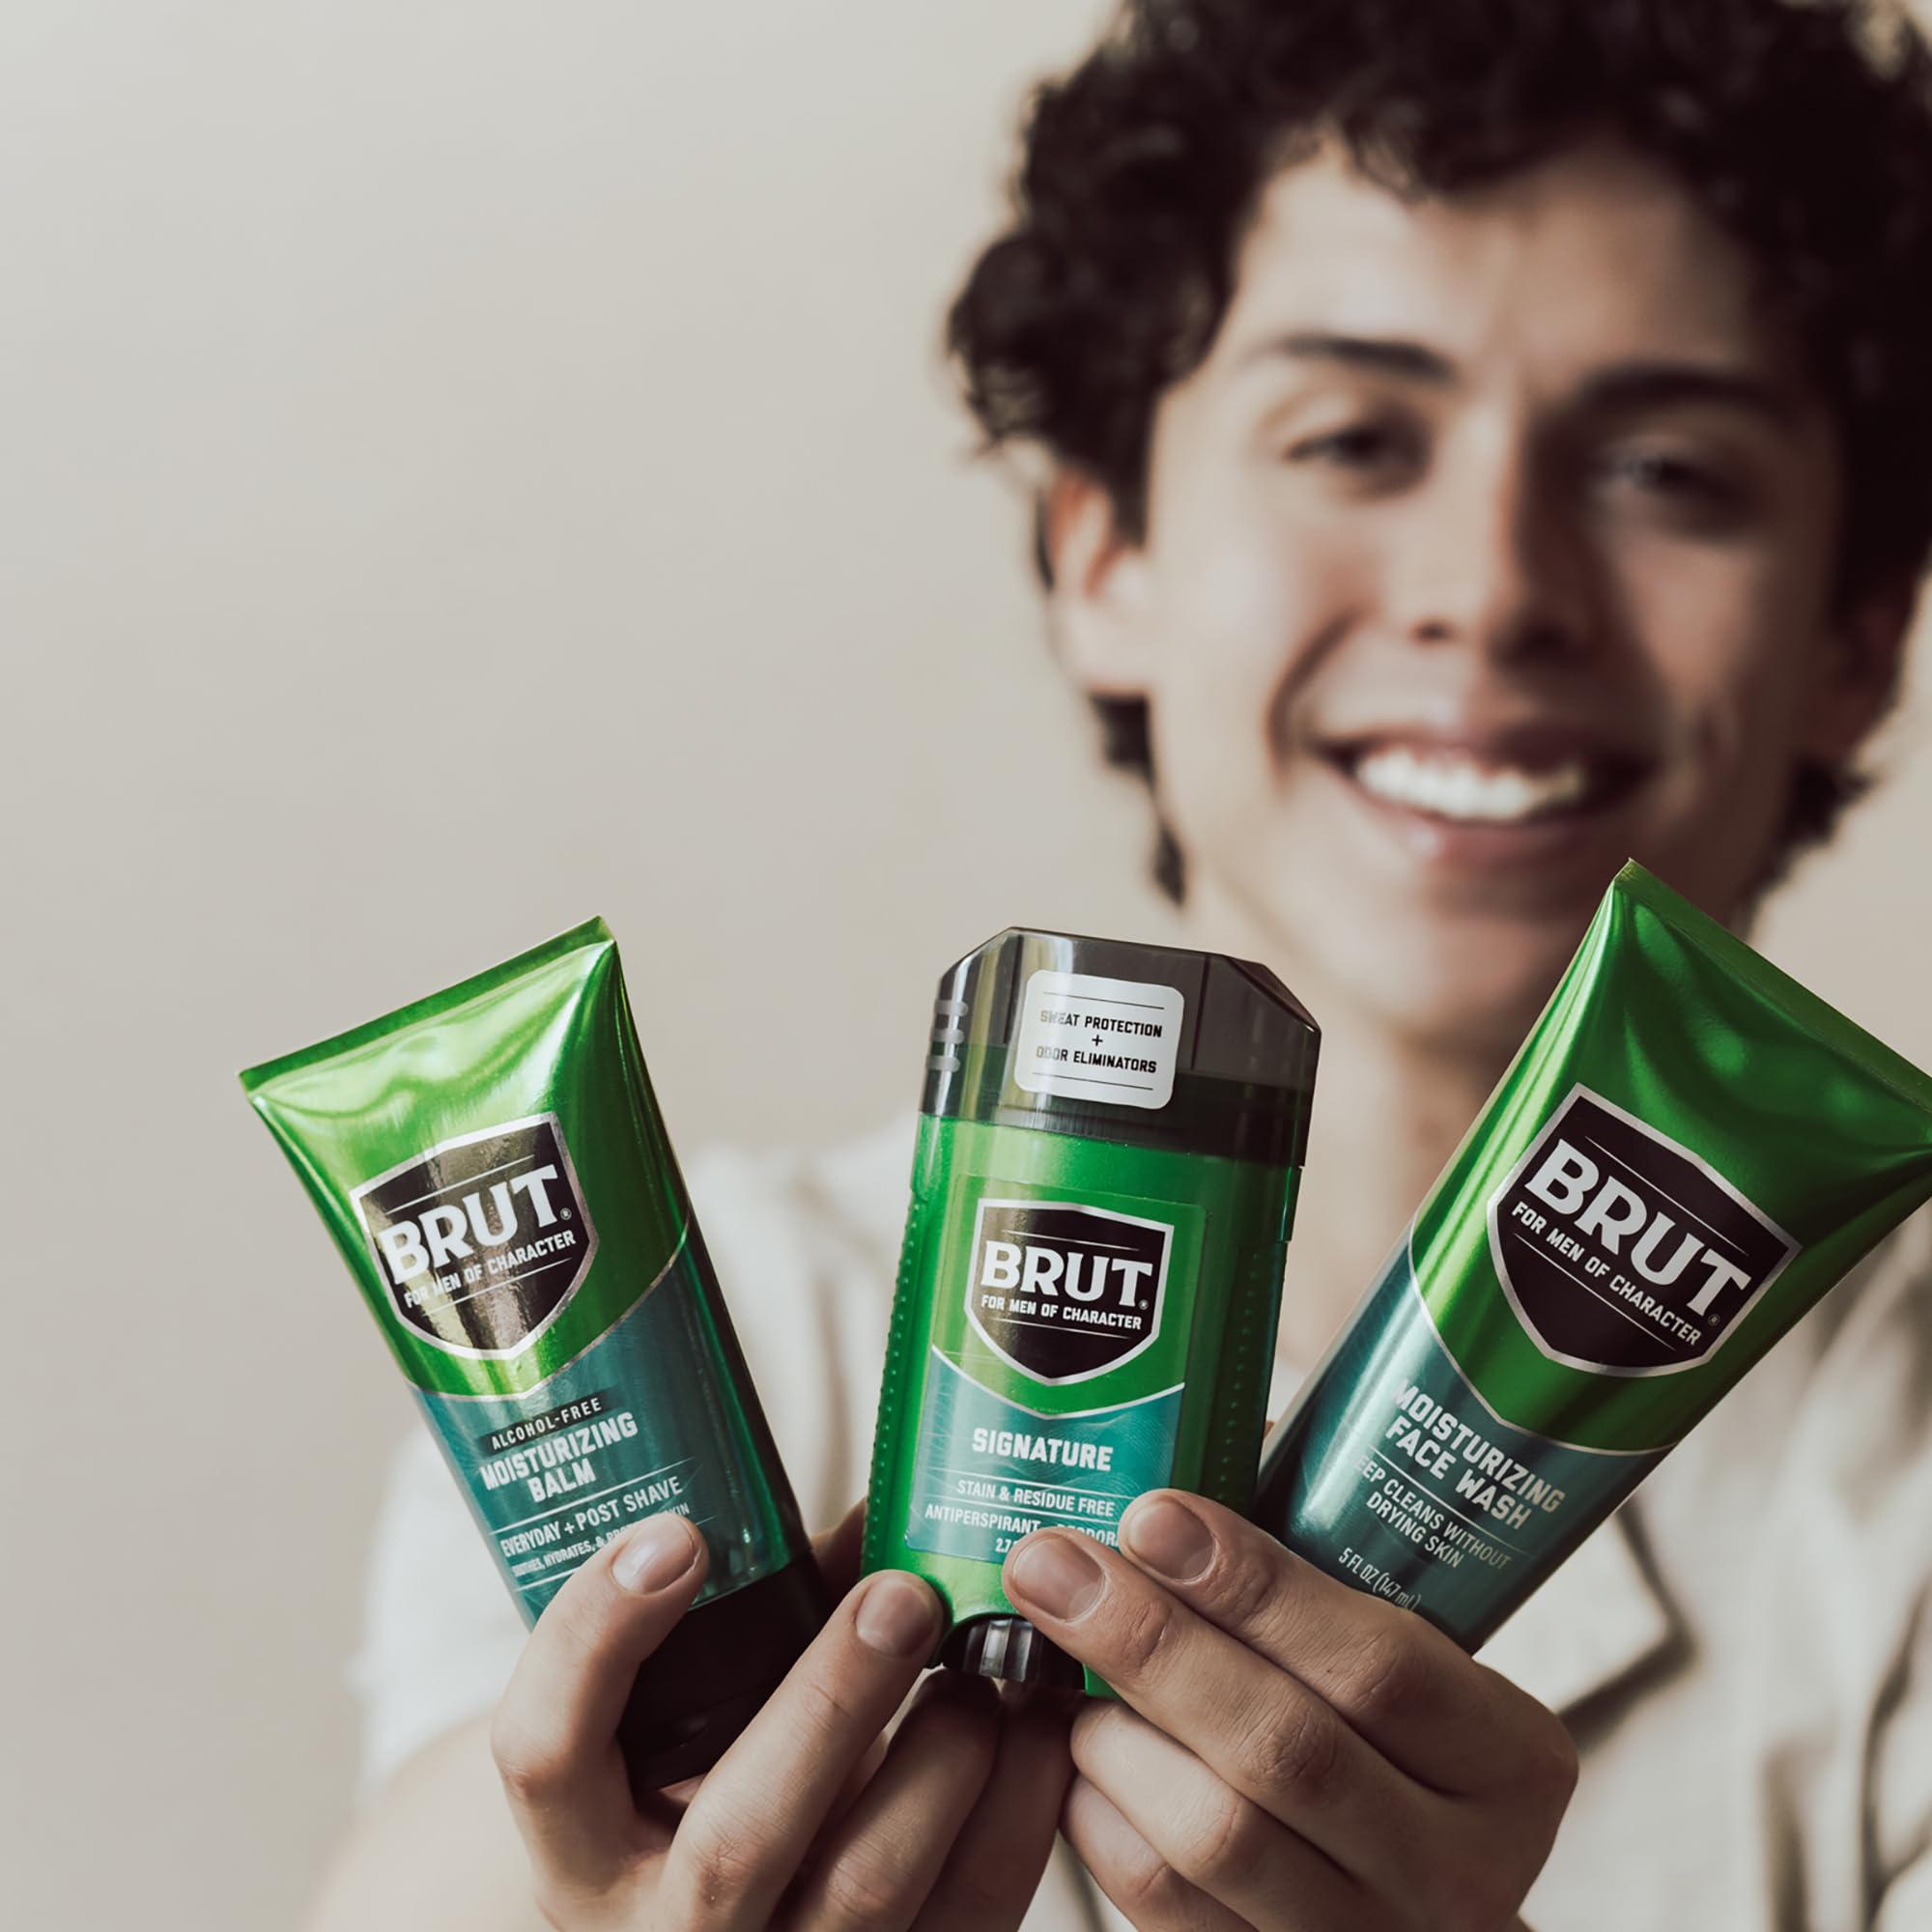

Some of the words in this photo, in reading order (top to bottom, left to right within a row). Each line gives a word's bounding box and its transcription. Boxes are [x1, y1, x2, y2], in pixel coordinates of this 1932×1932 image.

[1040, 1010, 1080, 1026] SWEAT
[1084, 1015, 1162, 1037] PROTECTION
[1092, 1035, 1103, 1046] +
[1036, 1045, 1068, 1062] ODOR
[1073, 1050, 1157, 1073] ELIMINATORS
[378, 1163, 558, 1285] BRUT
[1523, 1137, 1752, 1317] BRUT
[404, 1286, 429, 1308] FOR
[433, 1272, 462, 1296] MEN
[465, 1263, 484, 1285] OF
[487, 1229, 577, 1275] CHARACTER
[980, 1239, 1153, 1307] BRUT
[1511, 1201, 1547, 1236] FOR
[1546, 1228, 1586, 1263] MEN
[1584, 1256, 1611, 1278] OF
[1608, 1274, 1703, 1346] CHARACTER
[980, 1294, 1006, 1309] FOR
[1009, 1297, 1037, 1315] MEN
[1040, 1301, 1059, 1318] OF
[1063, 1306, 1143, 1330] CHARACTER
[480, 1411, 639, 1491] MOISTURIZING
[491, 1397, 602, 1450] ALCOHOL-FREE
[972, 1428, 1114, 1471] SIGNATURE
[1392, 1378, 1566, 1514] MOISTURIZING
[526, 1458, 596, 1503] BALM
[957, 1479, 998, 1499] STAIN
[1000, 1488, 1010, 1501] &
[1013, 1489, 1075, 1512] RESIDUE
[1078, 1498, 1116, 1518] FREE
[1385, 1414, 1457, 1480] FACE
[1455, 1468, 1532, 1531] WASH
[499, 1520, 561, 1558] EVERYDAY
[563, 1521, 575, 1534] +
[575, 1499, 620, 1531] POST
[623, 1476, 683, 1513] SHAVE
[924, 1503, 1041, 1534] ANTIPERSPIRANT
[1366, 1492, 1427, 1544] DRYING
[1424, 1535, 1464, 1569] SKIN
[1382, 1478, 1445, 1530] CLEANS
[1443, 1521, 1514, 1570] WITHOUT
[1338, 1547, 1352, 1563] 5
[1346, 1553, 1365, 1575] FL
[1359, 1564, 1380, 1584] OZ
[1372, 1572, 1402, 1598] (147
